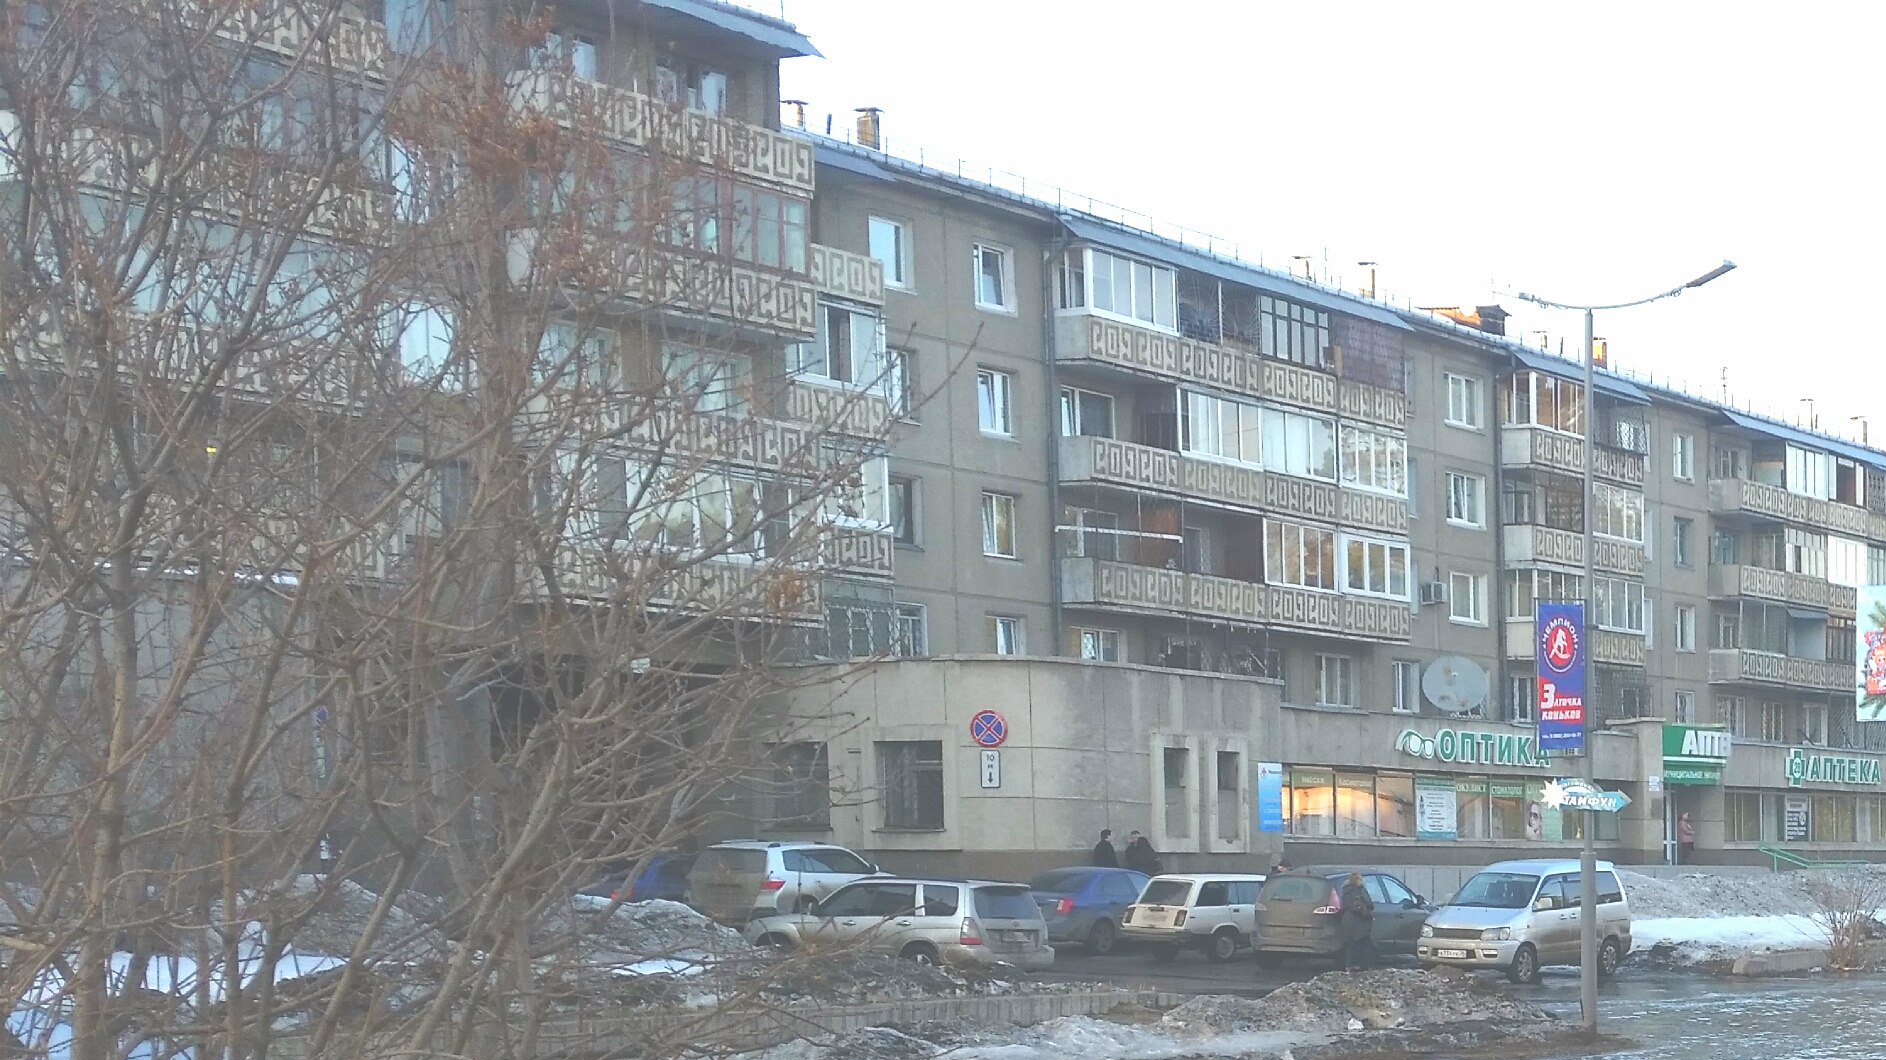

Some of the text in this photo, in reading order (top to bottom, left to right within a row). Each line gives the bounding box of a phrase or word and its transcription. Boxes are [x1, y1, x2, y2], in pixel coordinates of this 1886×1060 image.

[1542, 617, 1579, 643] ЧЕМПИОН
[1541, 709, 1582, 721] КОНЬКОВ
[986, 754, 995, 762] 10
[1435, 728, 1551, 768] ОПТИКА
[1806, 756, 1881, 784] АПТЕКА
